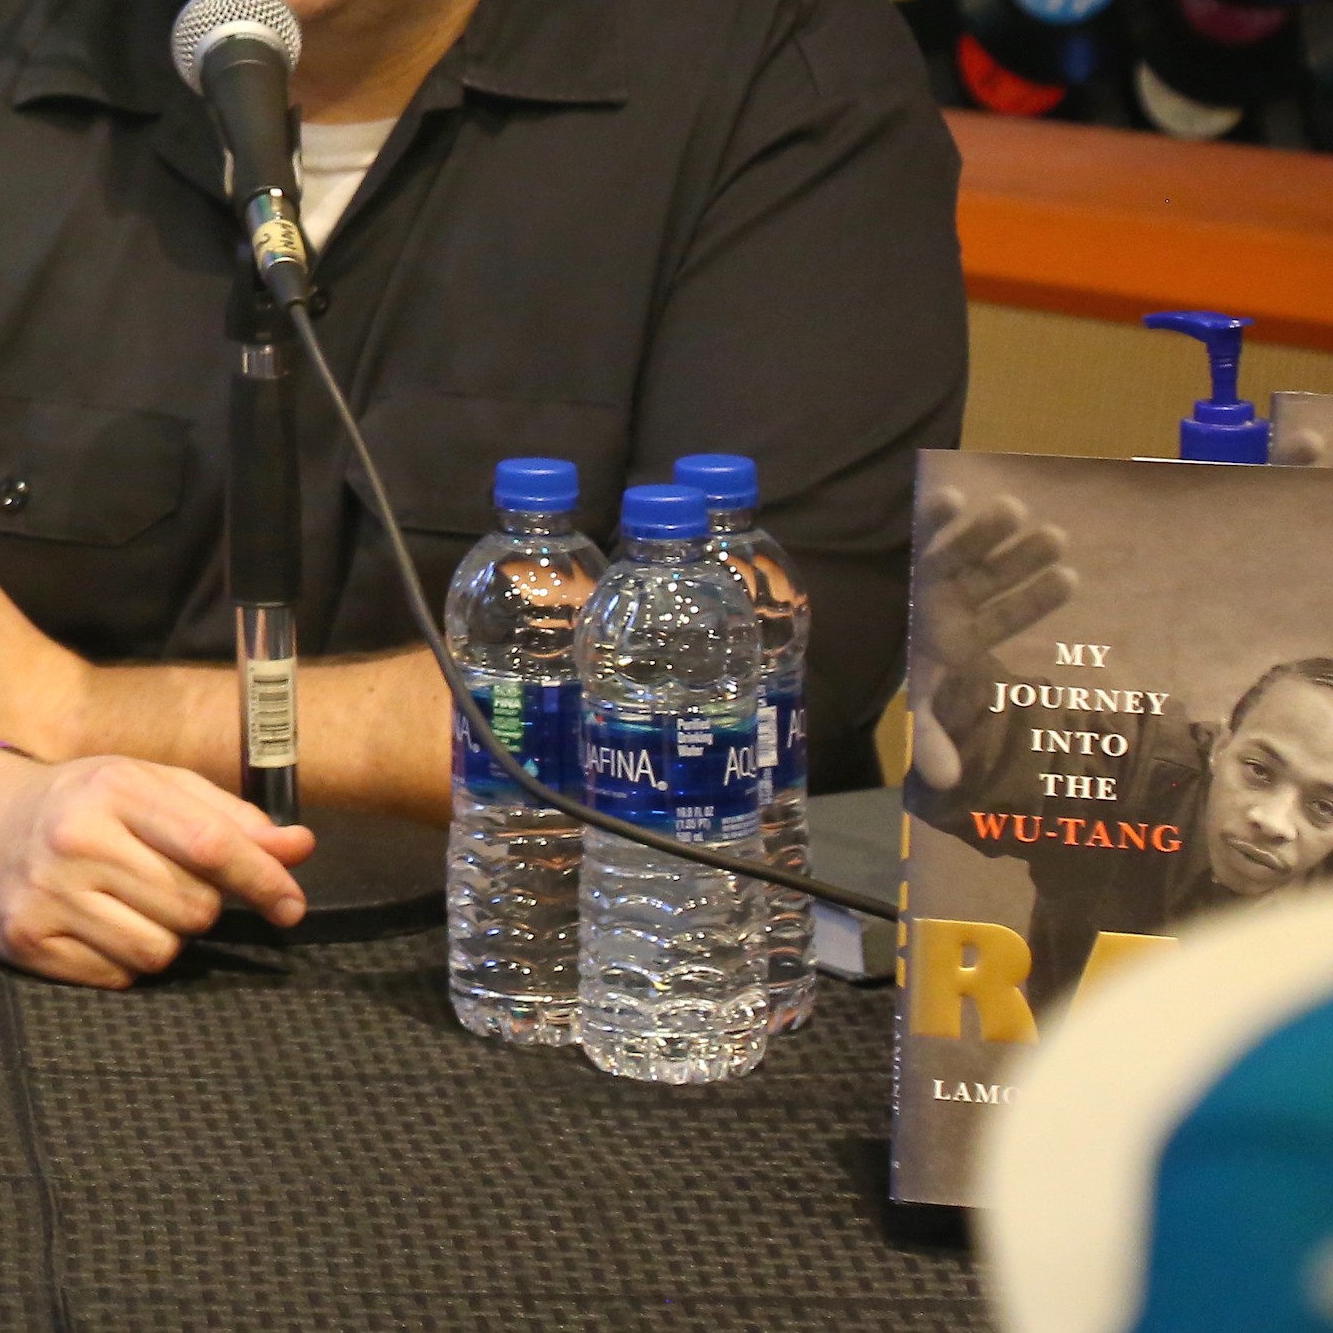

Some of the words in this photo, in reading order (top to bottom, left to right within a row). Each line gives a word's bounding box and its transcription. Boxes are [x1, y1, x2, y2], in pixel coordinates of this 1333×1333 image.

[1055, 642, 1111, 667] MY
[989, 682, 1170, 715] JOURNEY
[1030, 728, 1129, 757] INTO
[1039, 773, 1117, 801] THE
[970, 812, 1183, 853] WU-TANG
